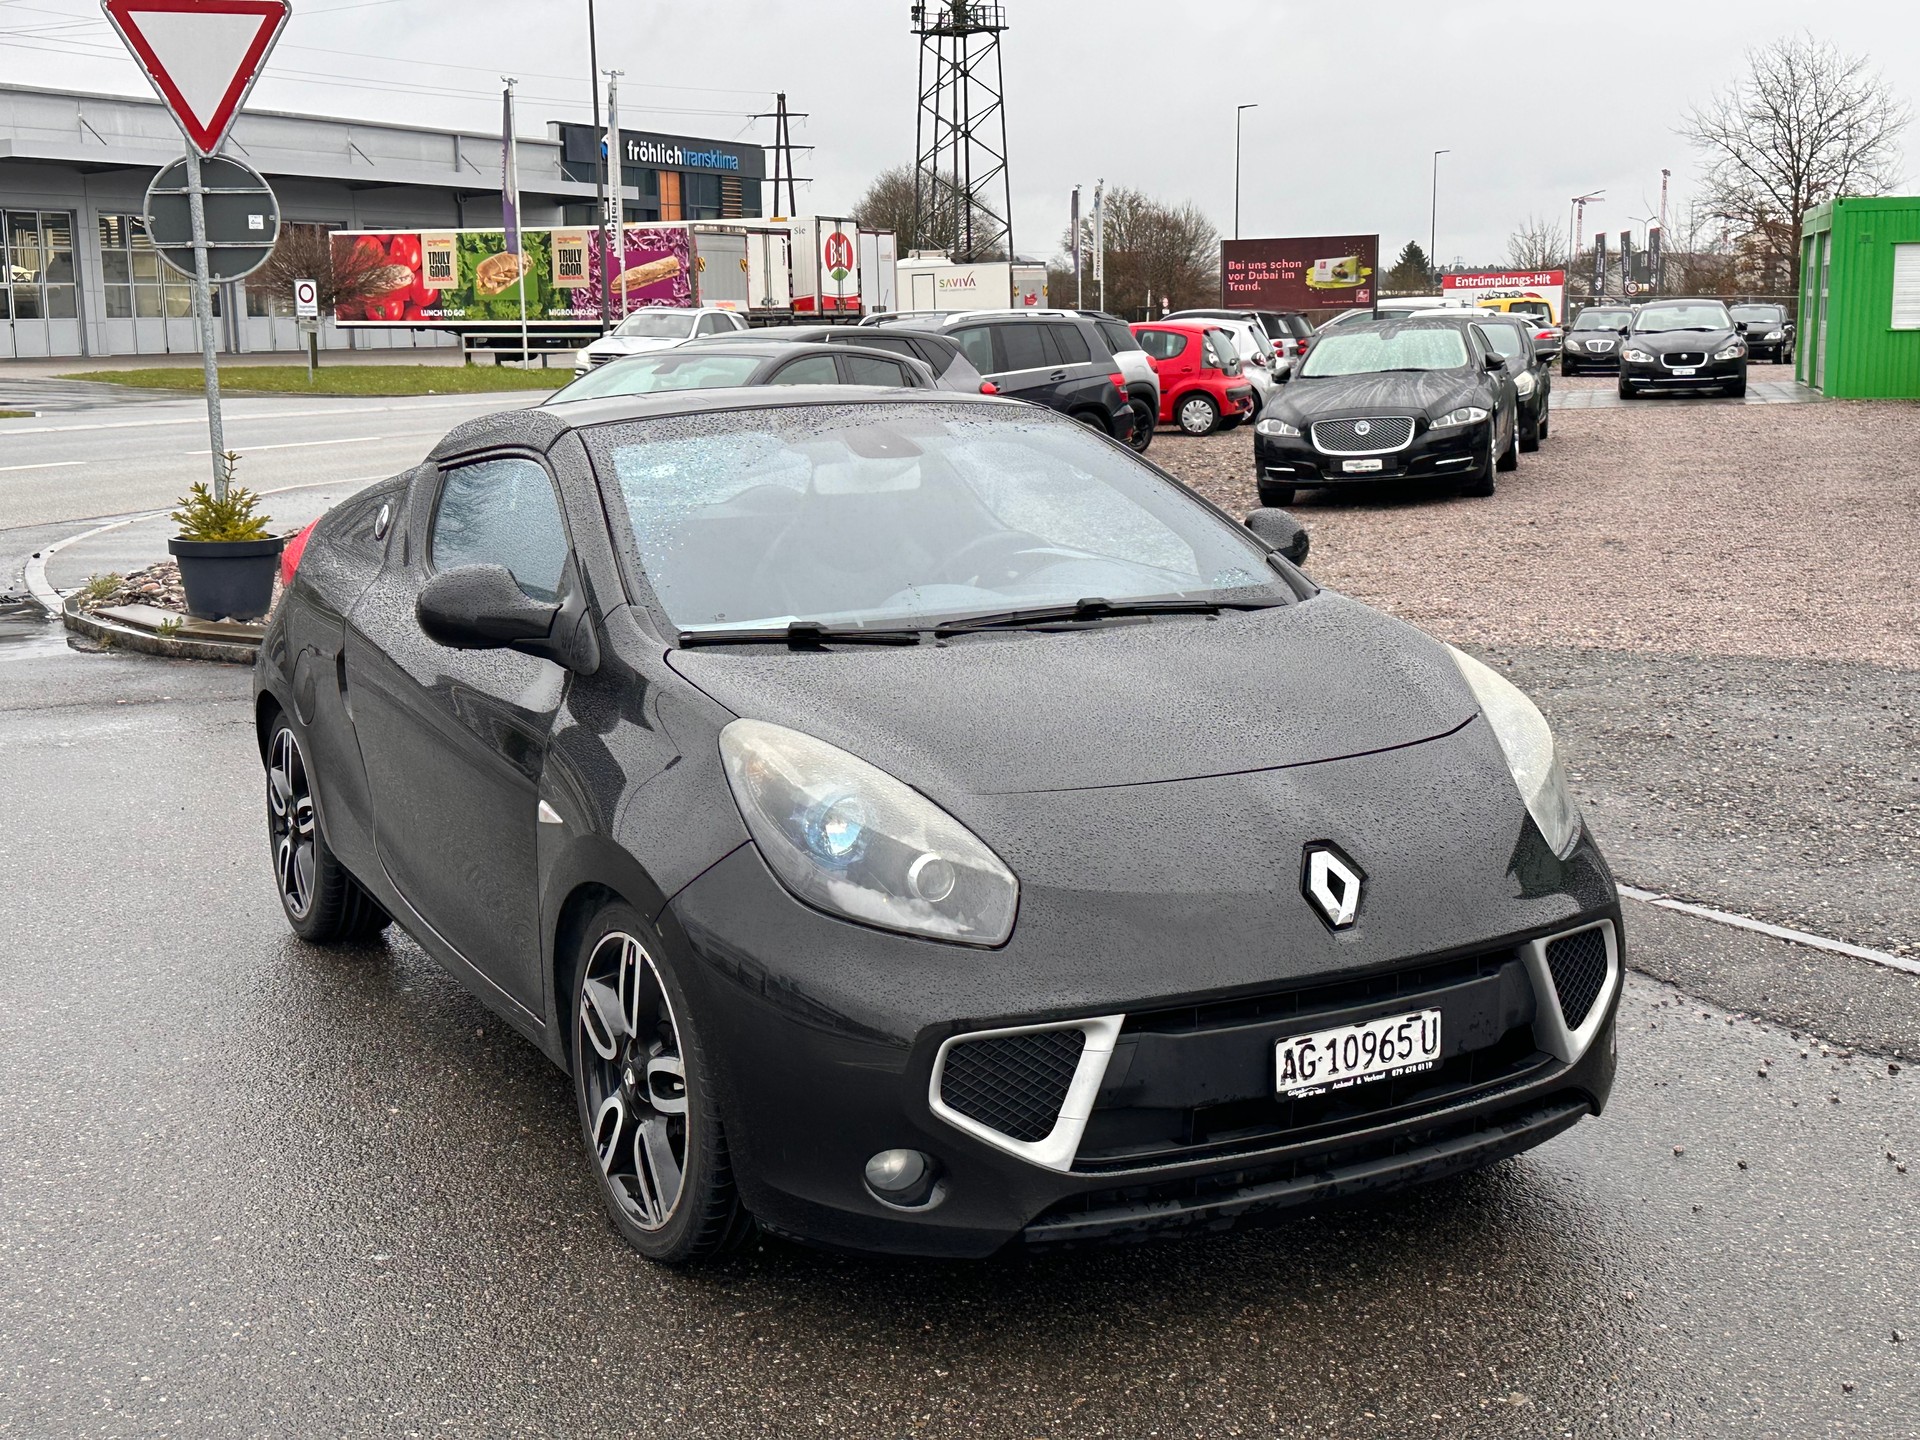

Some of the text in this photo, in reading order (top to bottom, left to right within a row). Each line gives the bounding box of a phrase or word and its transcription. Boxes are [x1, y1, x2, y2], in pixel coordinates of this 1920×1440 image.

[428, 251, 451, 265] TRULY
[558, 249, 582, 263] TRULY
[560, 262, 582, 276] GOOD
[1270, 258, 1302, 269] schon
[430, 264, 451, 278] GOOD
[1228, 269, 1295, 281] vor Dubai im
[939, 271, 976, 288] SAVIVA
[1228, 280, 1261, 291] Trend.
[1455, 273, 1551, 287] Entrümplungs-Hit
[420, 309, 443, 317] LUNCH
[443, 309, 453, 317] TO
[548, 308, 598, 316] MIGROLINO.CH
